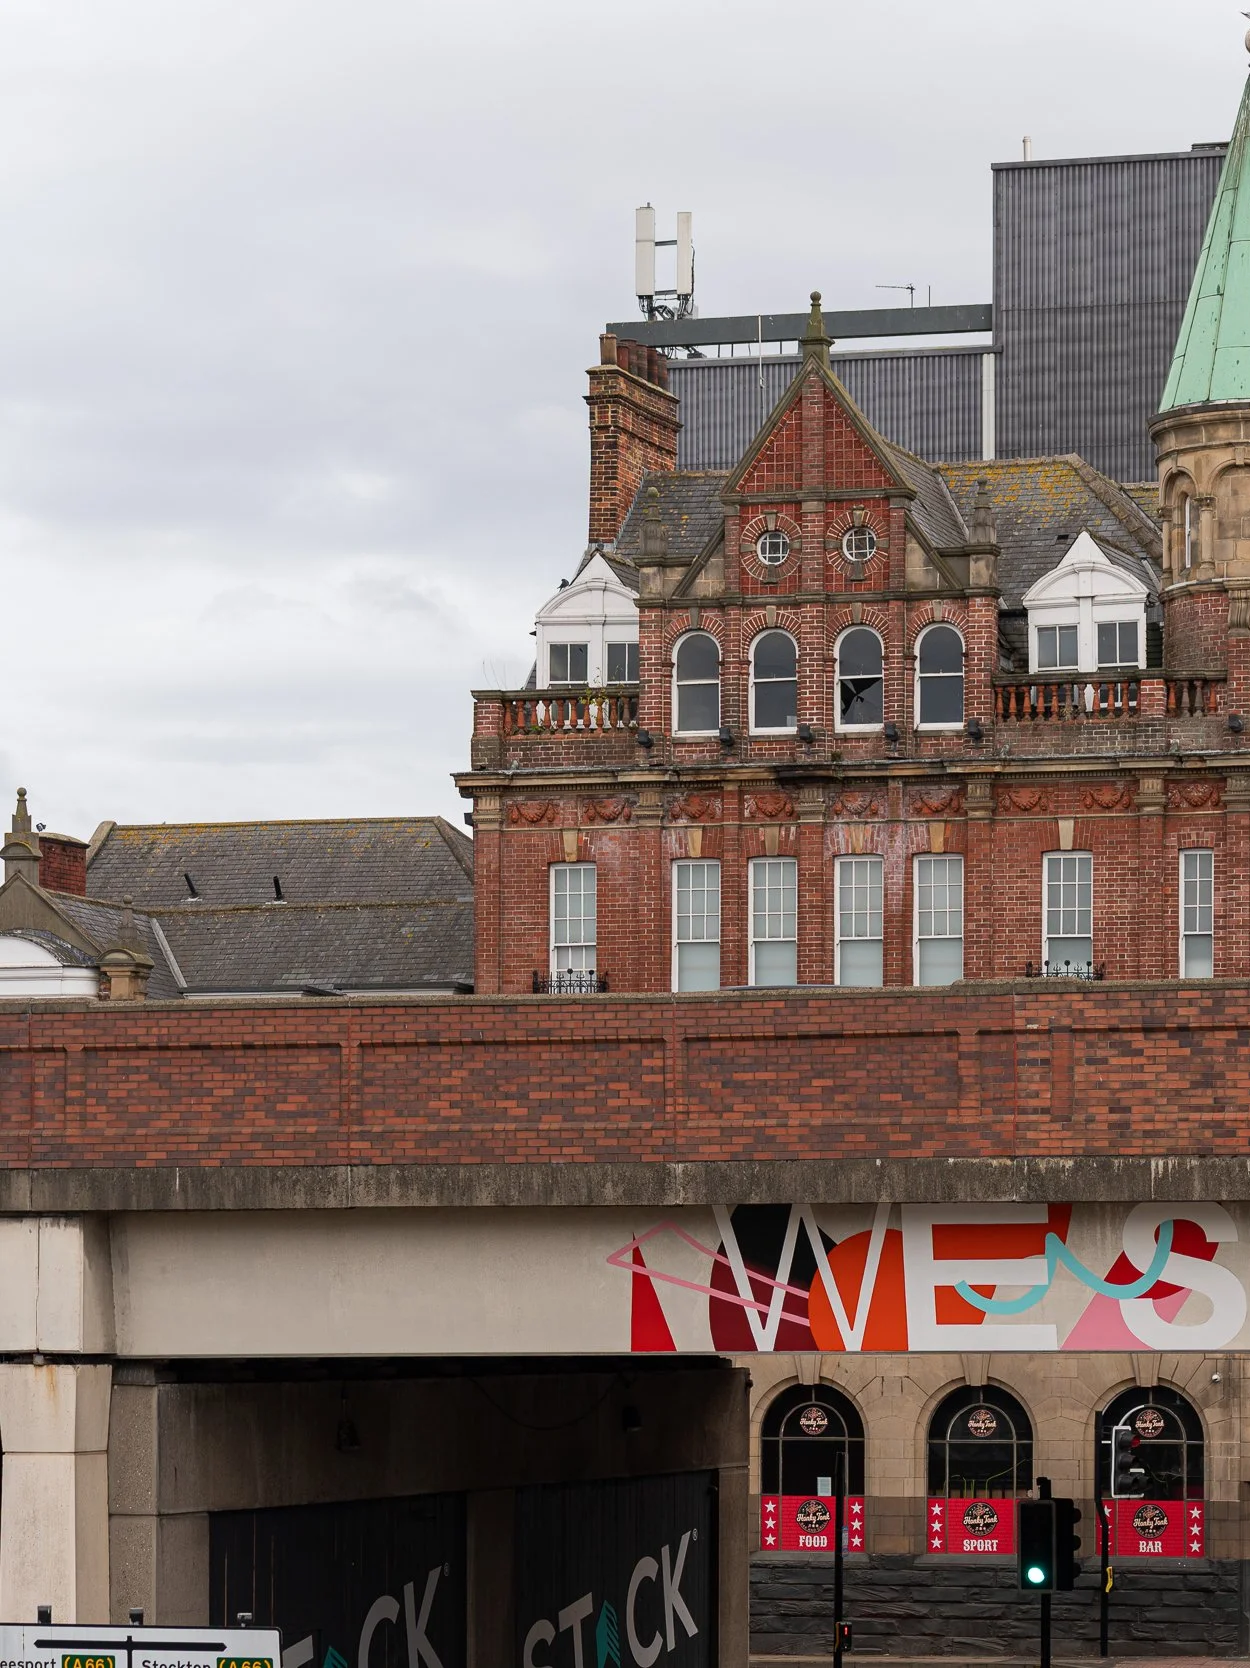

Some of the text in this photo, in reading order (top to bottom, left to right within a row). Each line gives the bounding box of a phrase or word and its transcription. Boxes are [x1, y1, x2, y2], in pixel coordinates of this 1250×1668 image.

[713, 1203, 1058, 1351] WE
[796, 1512, 830, 1524] Honky Tonk
[964, 1514, 998, 1526] Honky Tonk
[1133, 1516, 1168, 1529] Honky Tonk
[799, 1535, 828, 1548] FOOD
[963, 1539, 998, 1552] SPORT
[1139, 1540, 1162, 1552] BAR
